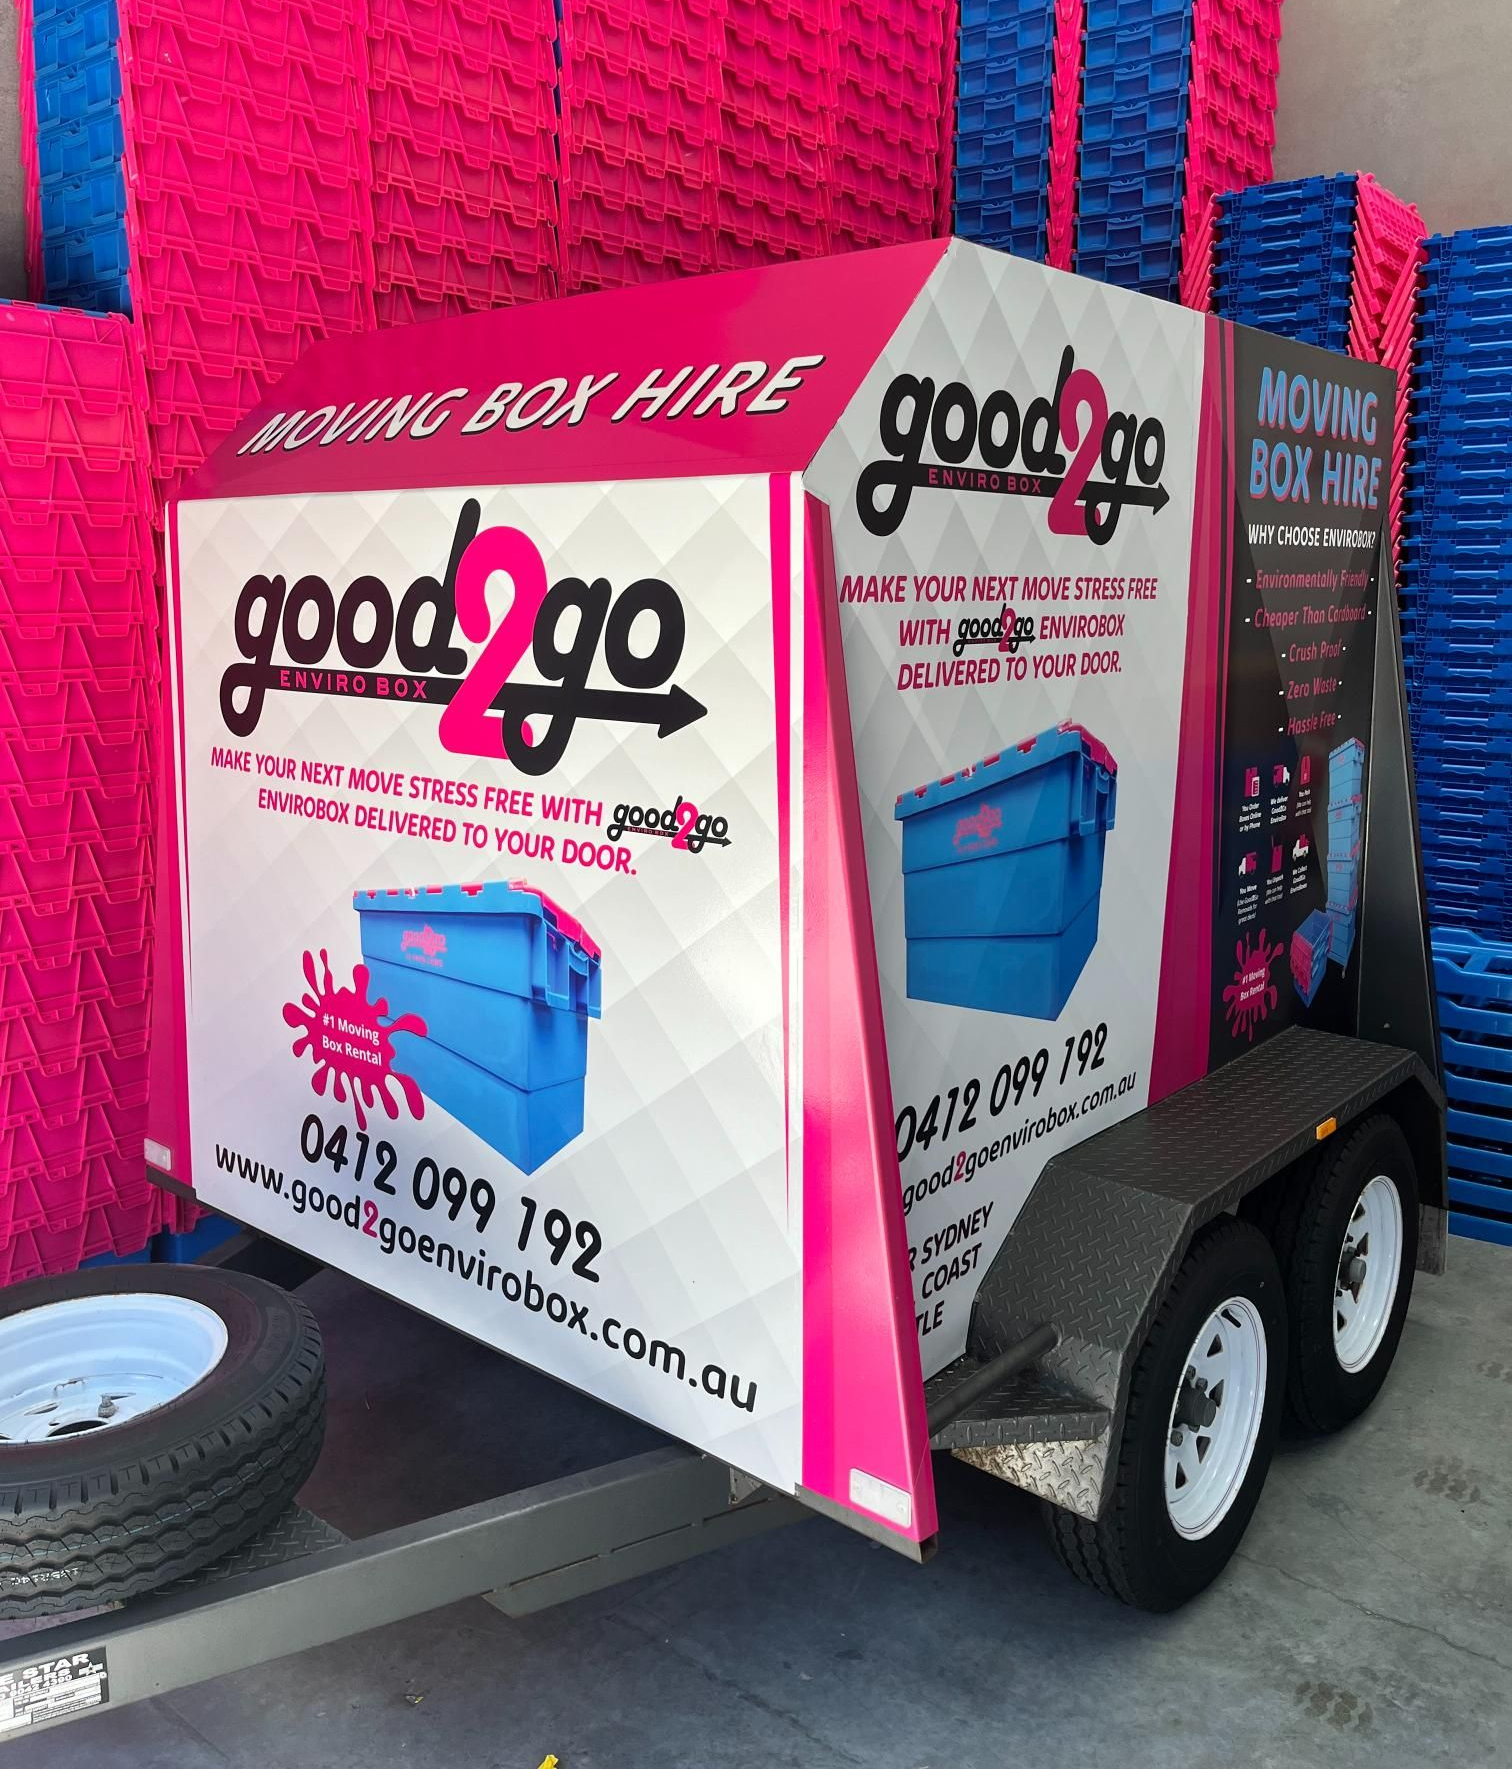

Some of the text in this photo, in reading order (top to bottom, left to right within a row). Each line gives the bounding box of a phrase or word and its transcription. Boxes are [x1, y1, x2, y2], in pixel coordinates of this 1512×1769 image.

[236, 354, 827, 457] MOVING BOX HIRE
[1258, 366, 1378, 447] MOVING
[856, 345, 1167, 545] good2go
[928, 468, 1042, 494] ENVIRO BOX
[1249, 438, 1383, 510] BOX HIRE
[1248, 523, 1377, 549] WHY CHOOSE ENVIROBOX?
[840, 575, 1158, 603] MAKE YOUR NEXT MOVE STRESS FREE
[1256, 569, 1369, 592] Environmentally Friendly
[219, 498, 686, 776] good2go
[899, 602, 1126, 657] WITH good2go ENVIROBOX
[1254, 603, 1366, 631] Cheaper Than Cardboard
[897, 650, 1122, 691] DELIVERED TO YOUR DOOR.
[1288, 639, 1342, 662] Crush Proof
[280, 670, 428, 700] ENVIRO BOX
[1286, 677, 1337, 699] Zero Waste
[1287, 711, 1336, 735] Hassle Free
[211, 746, 728, 854] MAKE YOUR NEXT MOVE STRESS FREE WITH good2go
[258, 788, 637, 875] ENVIROBOX DELIVERED TO YOUR DOOR.
[322, 1035, 382, 1066] Box Rental
[323, 1012, 380, 1046] #1 Moving
[895, 1022, 1108, 1163] 0412 099 192
[902, 1071, 1137, 1217] good2goenvirobox.com.au
[300, 1113, 602, 1283] 0412 099 192
[921, 1201, 994, 1265] SYDNEY
[215, 1143, 758, 1413] www.good2goenvirobox.com.au
[921, 1242, 982, 1300] COAST
[22, 1653, 90, 1680] STAR
